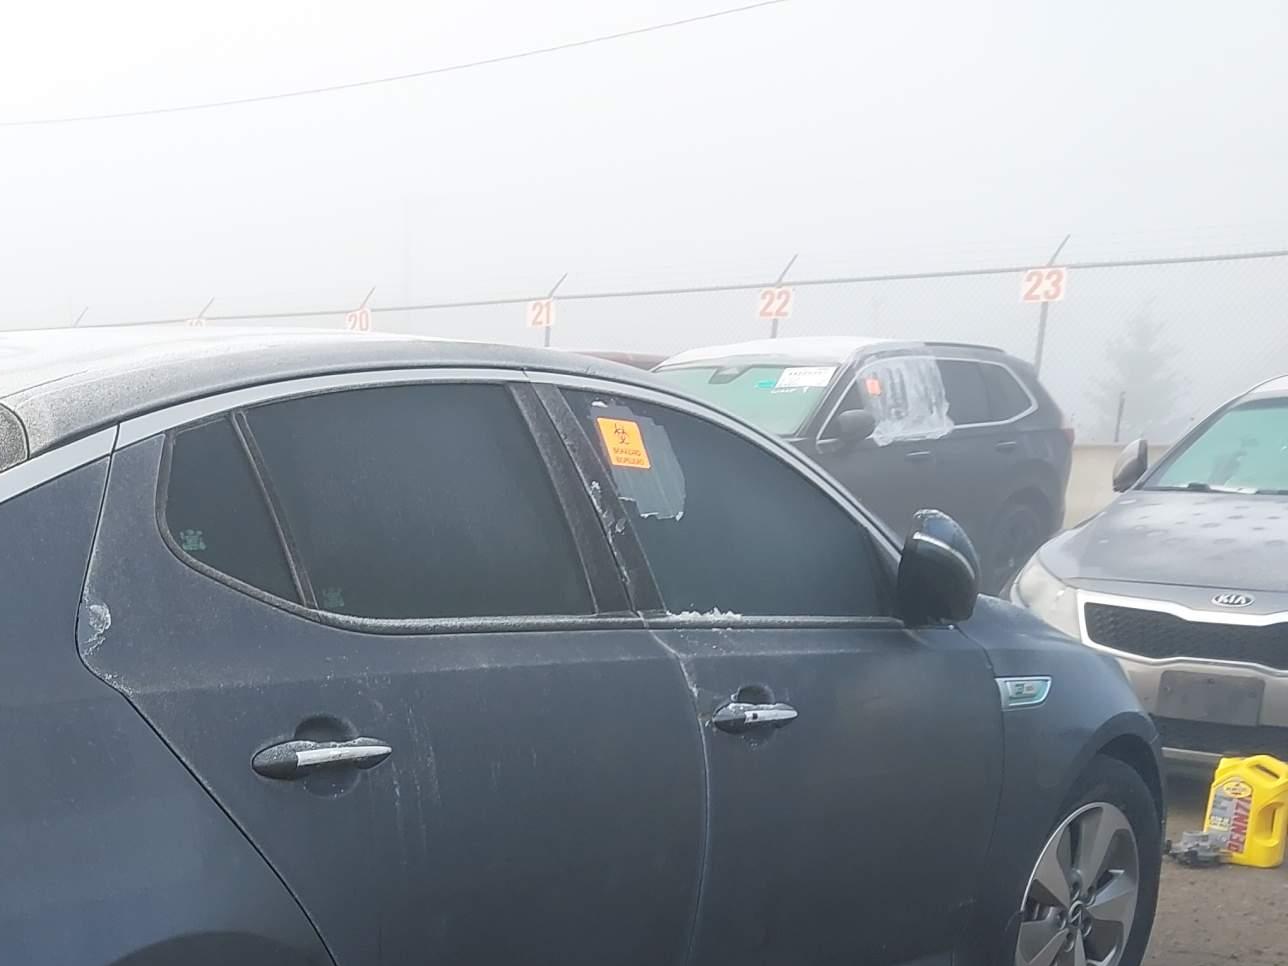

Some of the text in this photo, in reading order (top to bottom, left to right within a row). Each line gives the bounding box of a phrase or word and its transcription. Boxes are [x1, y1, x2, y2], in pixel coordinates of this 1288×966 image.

[1023, 270, 1063, 301] 23
[531, 302, 553, 326] 21
[759, 290, 791, 317] 22
[346, 310, 369, 331] 20
